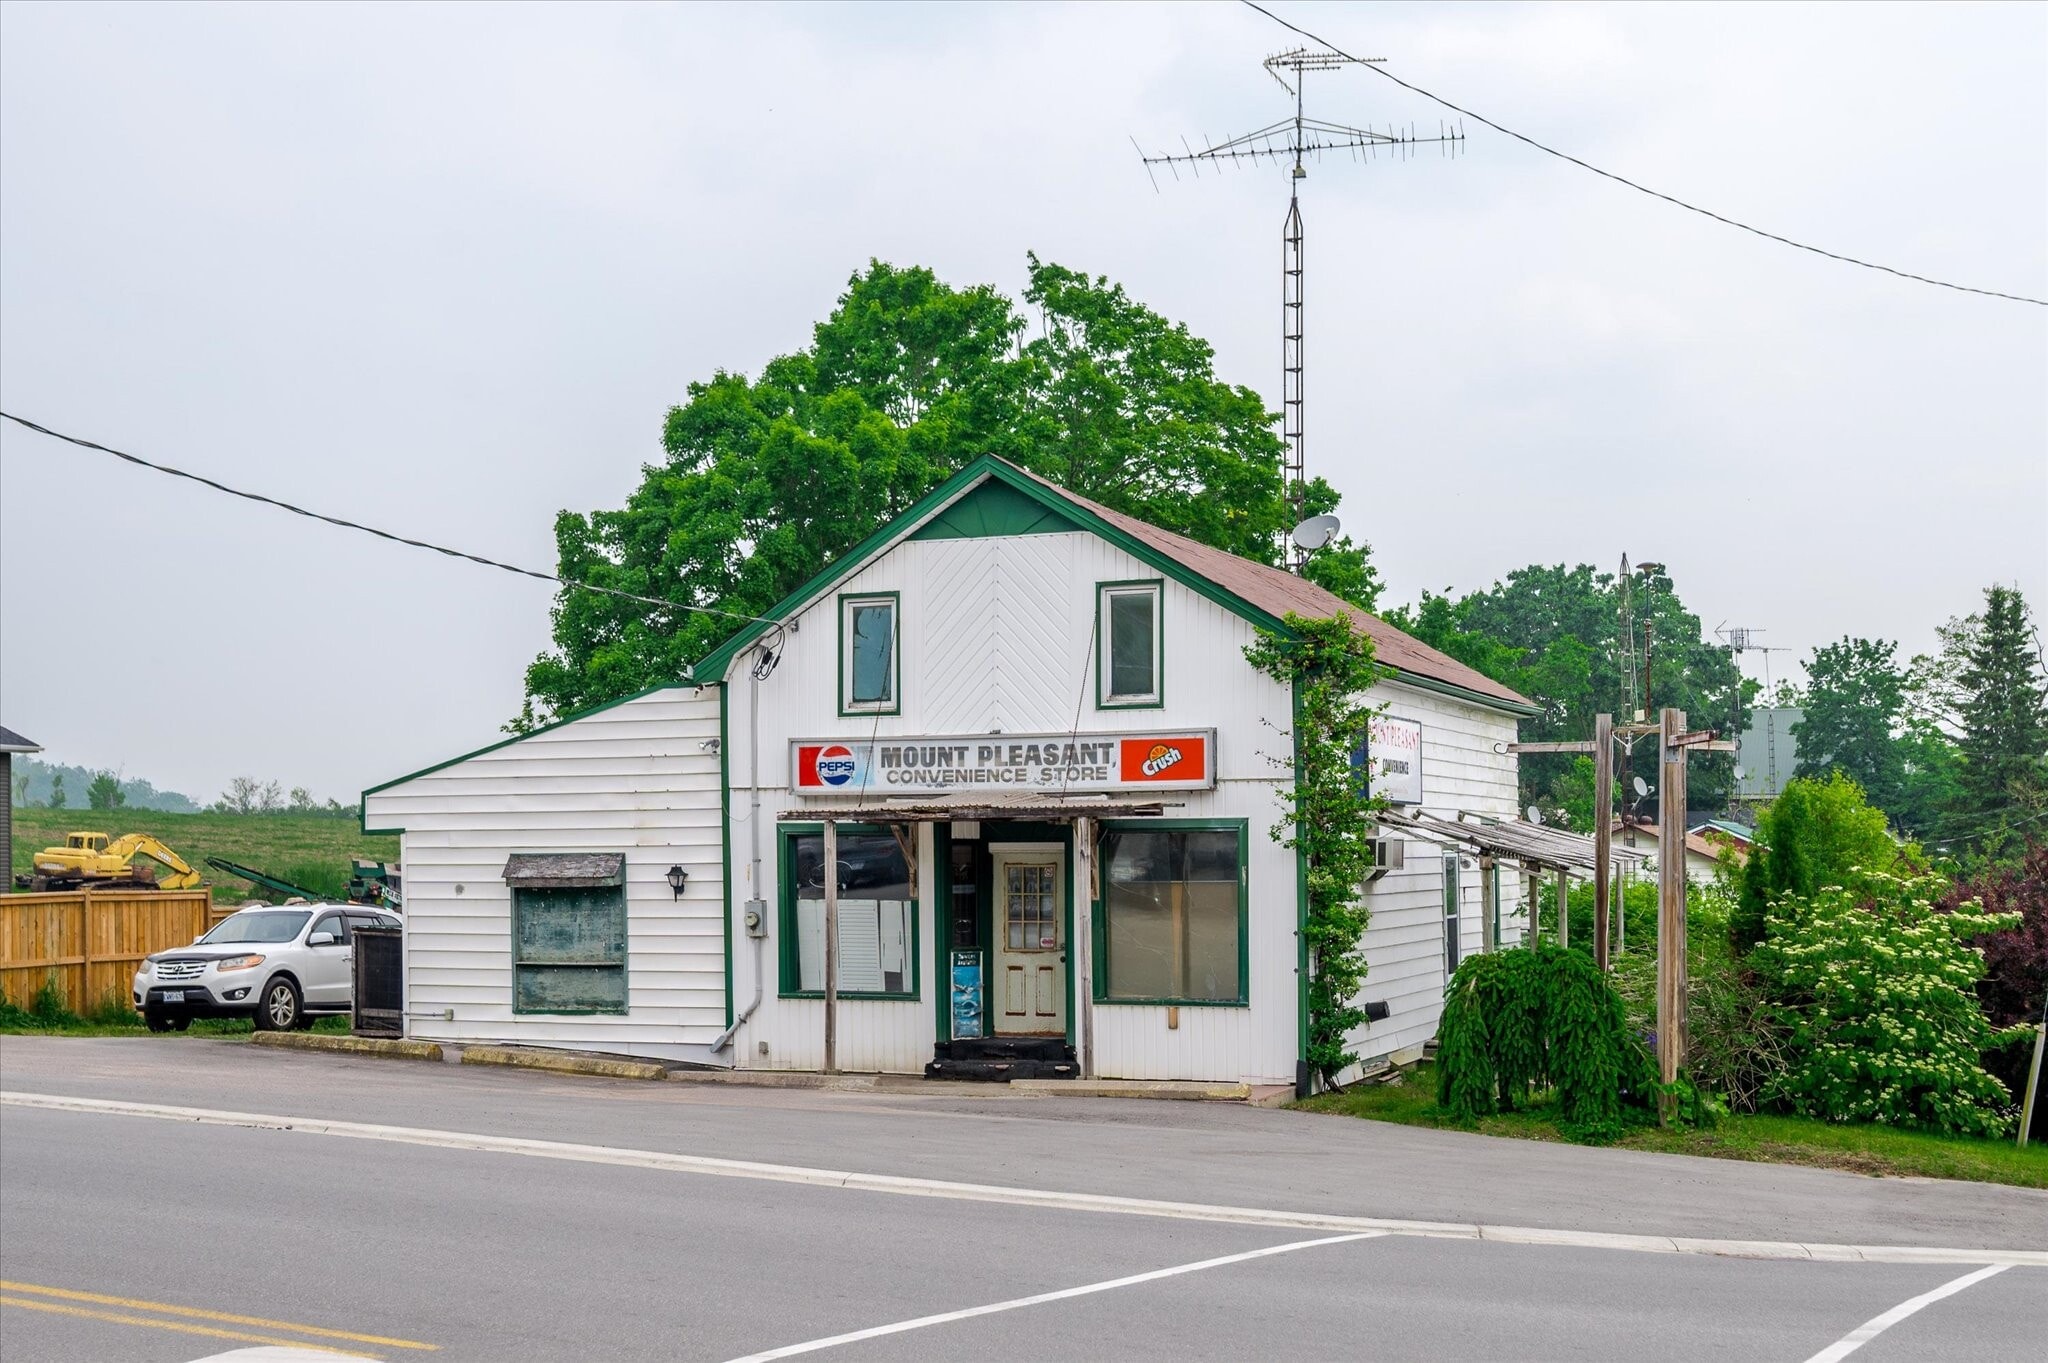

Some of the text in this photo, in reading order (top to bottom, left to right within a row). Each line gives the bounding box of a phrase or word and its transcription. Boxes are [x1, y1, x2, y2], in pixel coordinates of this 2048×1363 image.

[818, 761, 855, 772] PEPSI
[881, 746, 969, 768] MOUNT
[1141, 748, 1183, 777] Crush
[1383, 758, 1409, 775] CONVENIENCE
[887, 766, 1108, 785] CONVENIENCE STORE
